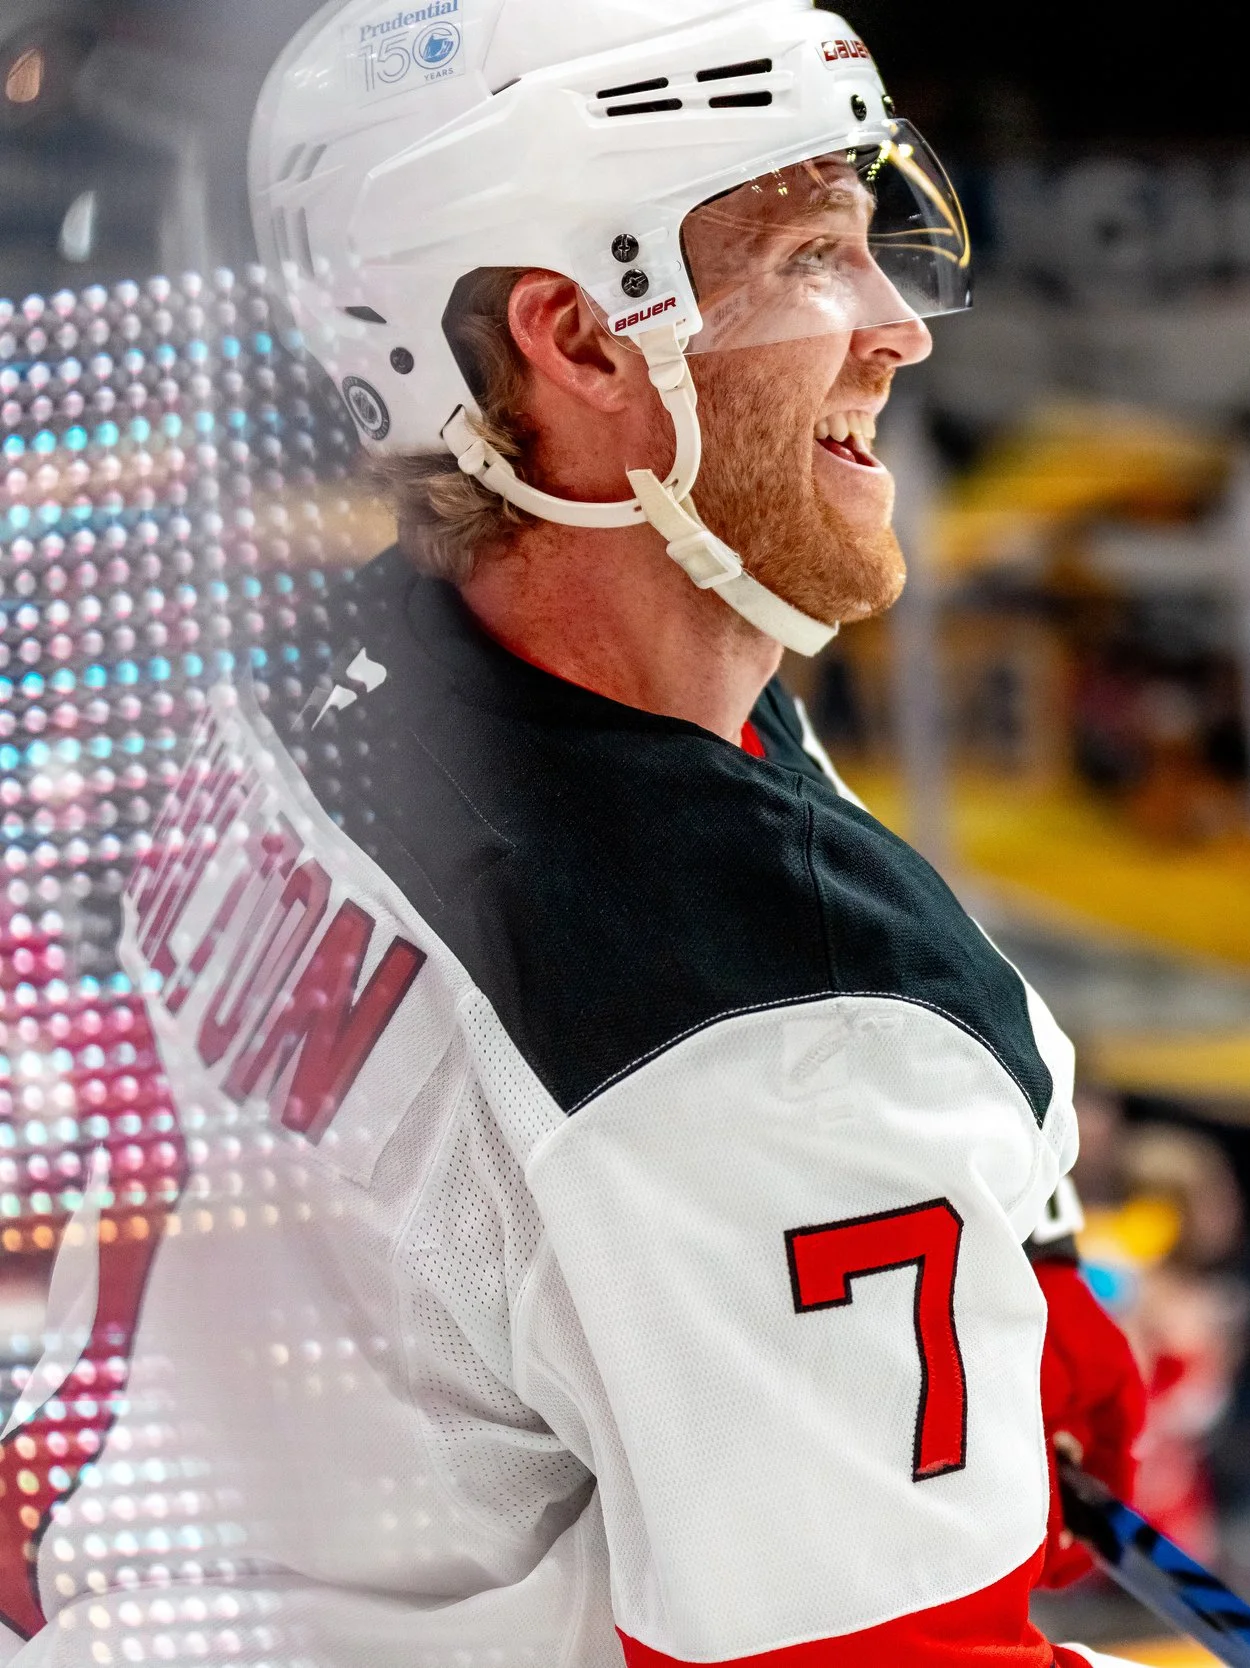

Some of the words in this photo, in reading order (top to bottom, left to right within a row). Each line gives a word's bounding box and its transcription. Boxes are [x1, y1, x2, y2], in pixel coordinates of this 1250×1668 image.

[360, 0, 459, 42] Prudential
[424, 67, 454, 81] YEARS
[783, 1196, 969, 1483] 7
